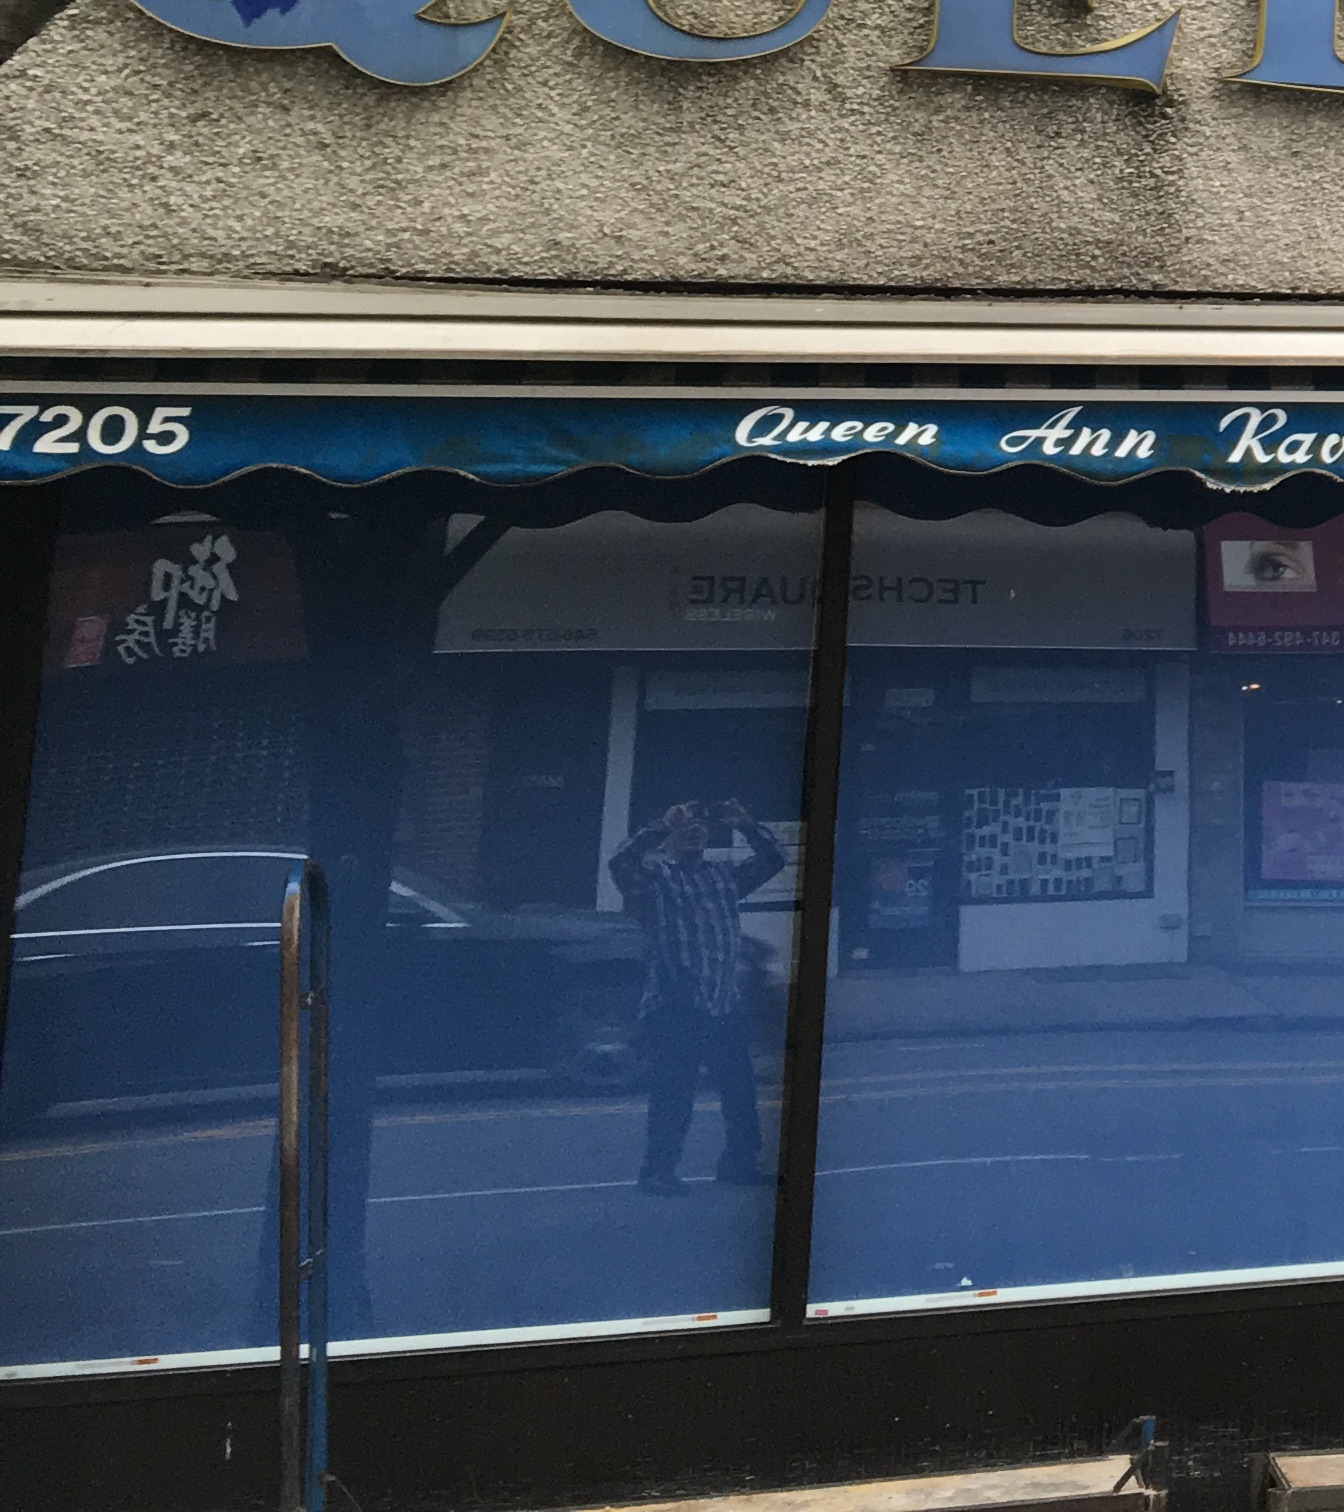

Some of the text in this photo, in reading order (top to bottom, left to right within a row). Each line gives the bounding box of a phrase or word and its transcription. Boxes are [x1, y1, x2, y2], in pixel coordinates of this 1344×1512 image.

[0, 405, 192, 455] 7205
[734, 405, 940, 447] Queen
[998, 405, 1157, 457] Ann
